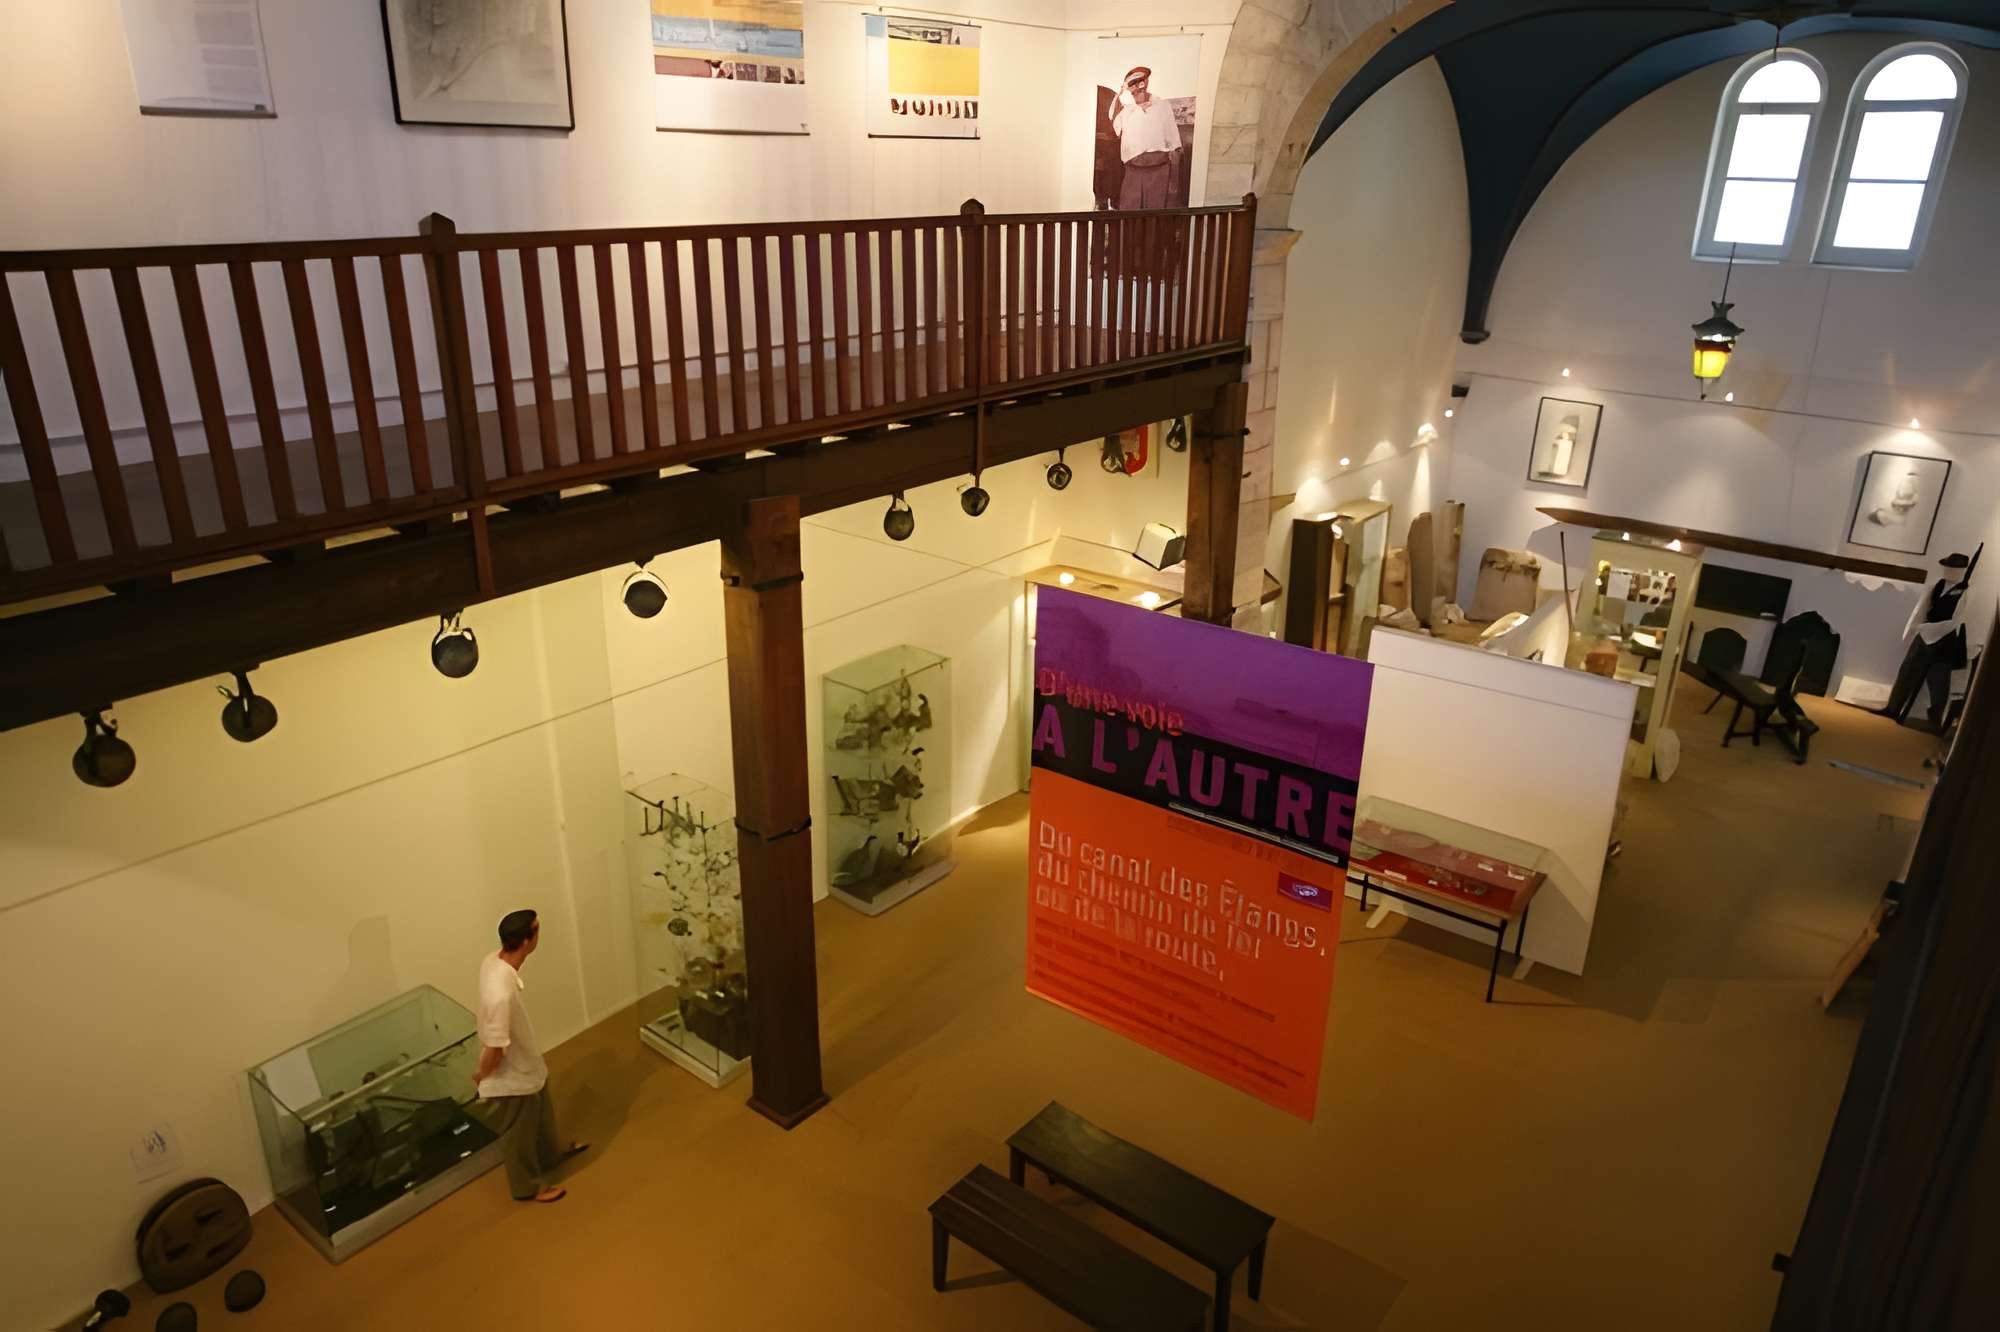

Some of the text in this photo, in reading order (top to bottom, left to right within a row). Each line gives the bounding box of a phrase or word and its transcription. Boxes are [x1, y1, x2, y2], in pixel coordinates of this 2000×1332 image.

[1033, 703, 1066, 759] A
[1092, 719, 1356, 850] L'AUTRE
[1040, 820, 1070, 858] Du
